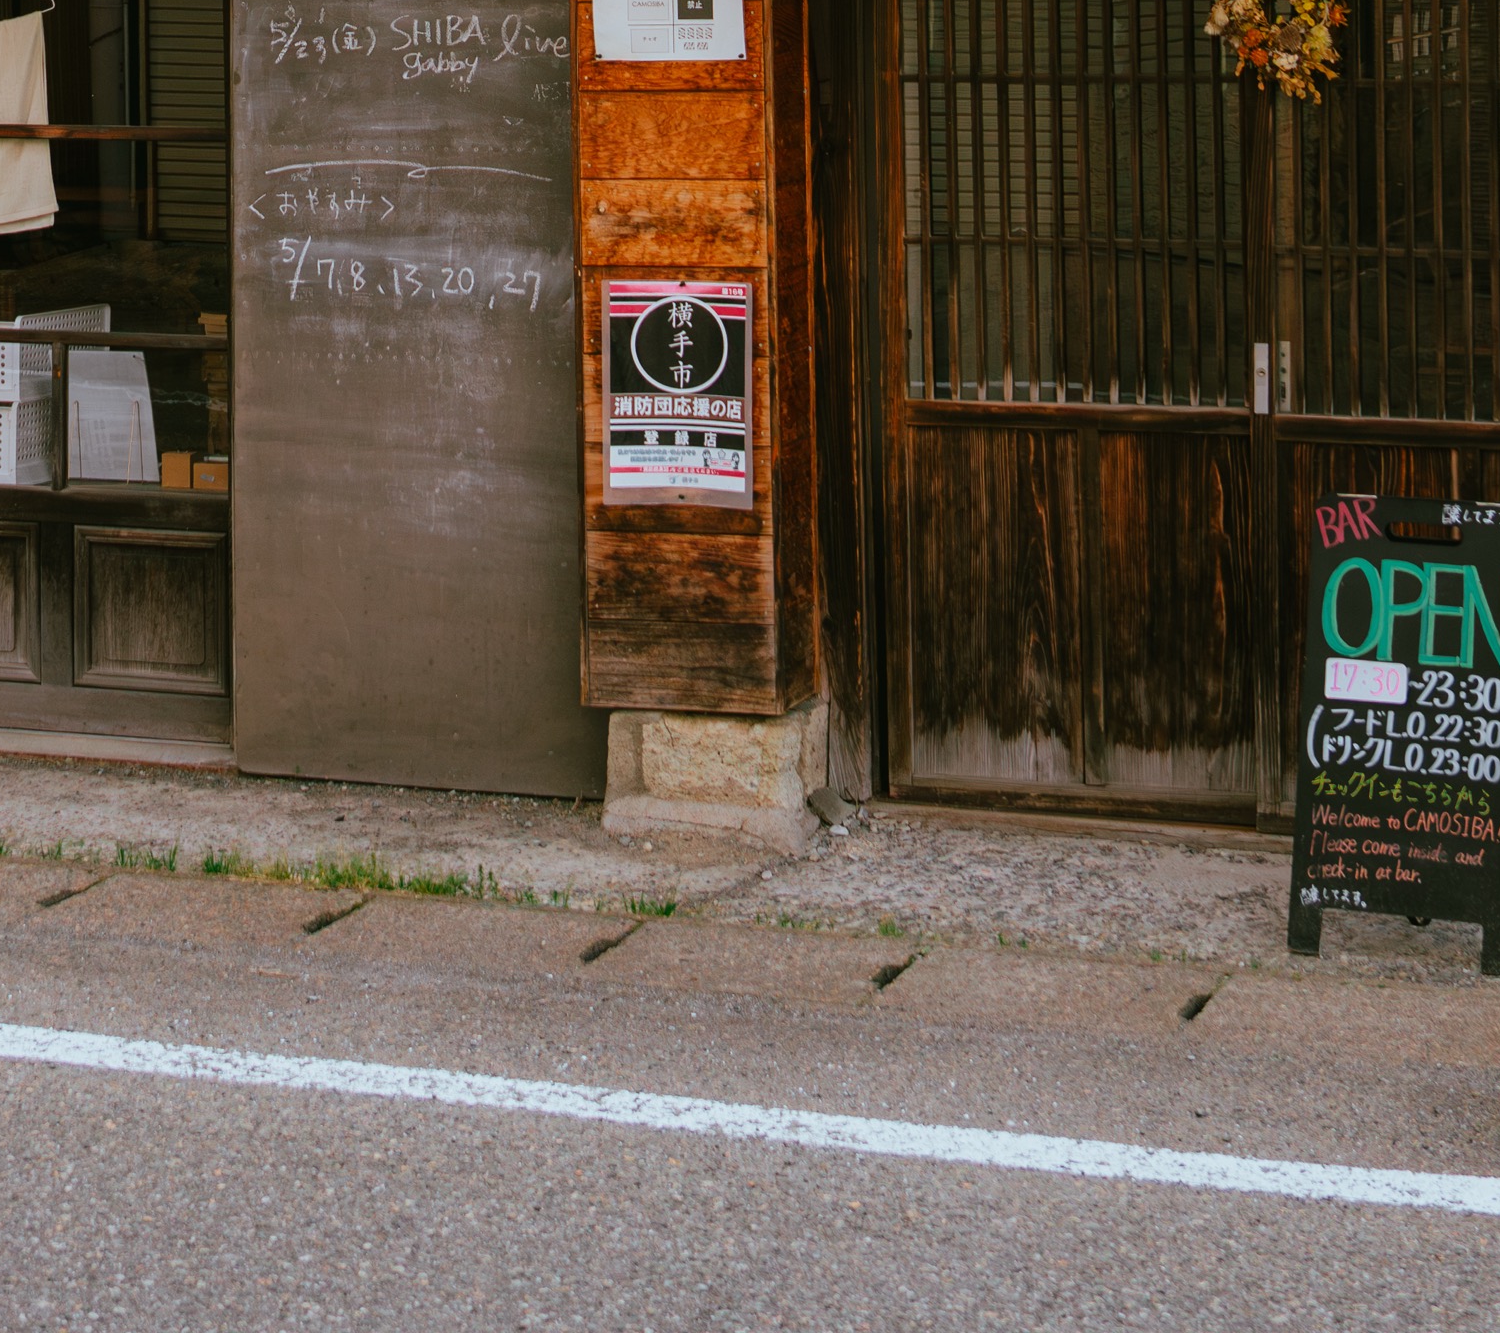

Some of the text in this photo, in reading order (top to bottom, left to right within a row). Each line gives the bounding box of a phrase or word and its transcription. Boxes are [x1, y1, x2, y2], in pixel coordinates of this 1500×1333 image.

[391, 14, 487, 51] SHIBA
[493, 13, 571, 61] live
[667, 301, 693, 389] 横手市
[614, 396, 742, 420] 消防団応援の店
[1315, 498, 1384, 549] BAR
[1329, 661, 1401, 697] 17:30
[1311, 770, 1491, 816] チェックインもこちらから
[1311, 803, 1381, 829] Welcome
[1386, 816, 1400, 831] to
[1362, 838, 1400, 858] come
[1408, 841, 1448, 863] inside
[1455, 848, 1486, 867] and
[1375, 866, 1393, 881] at
[1394, 859, 1422, 884] bar.
